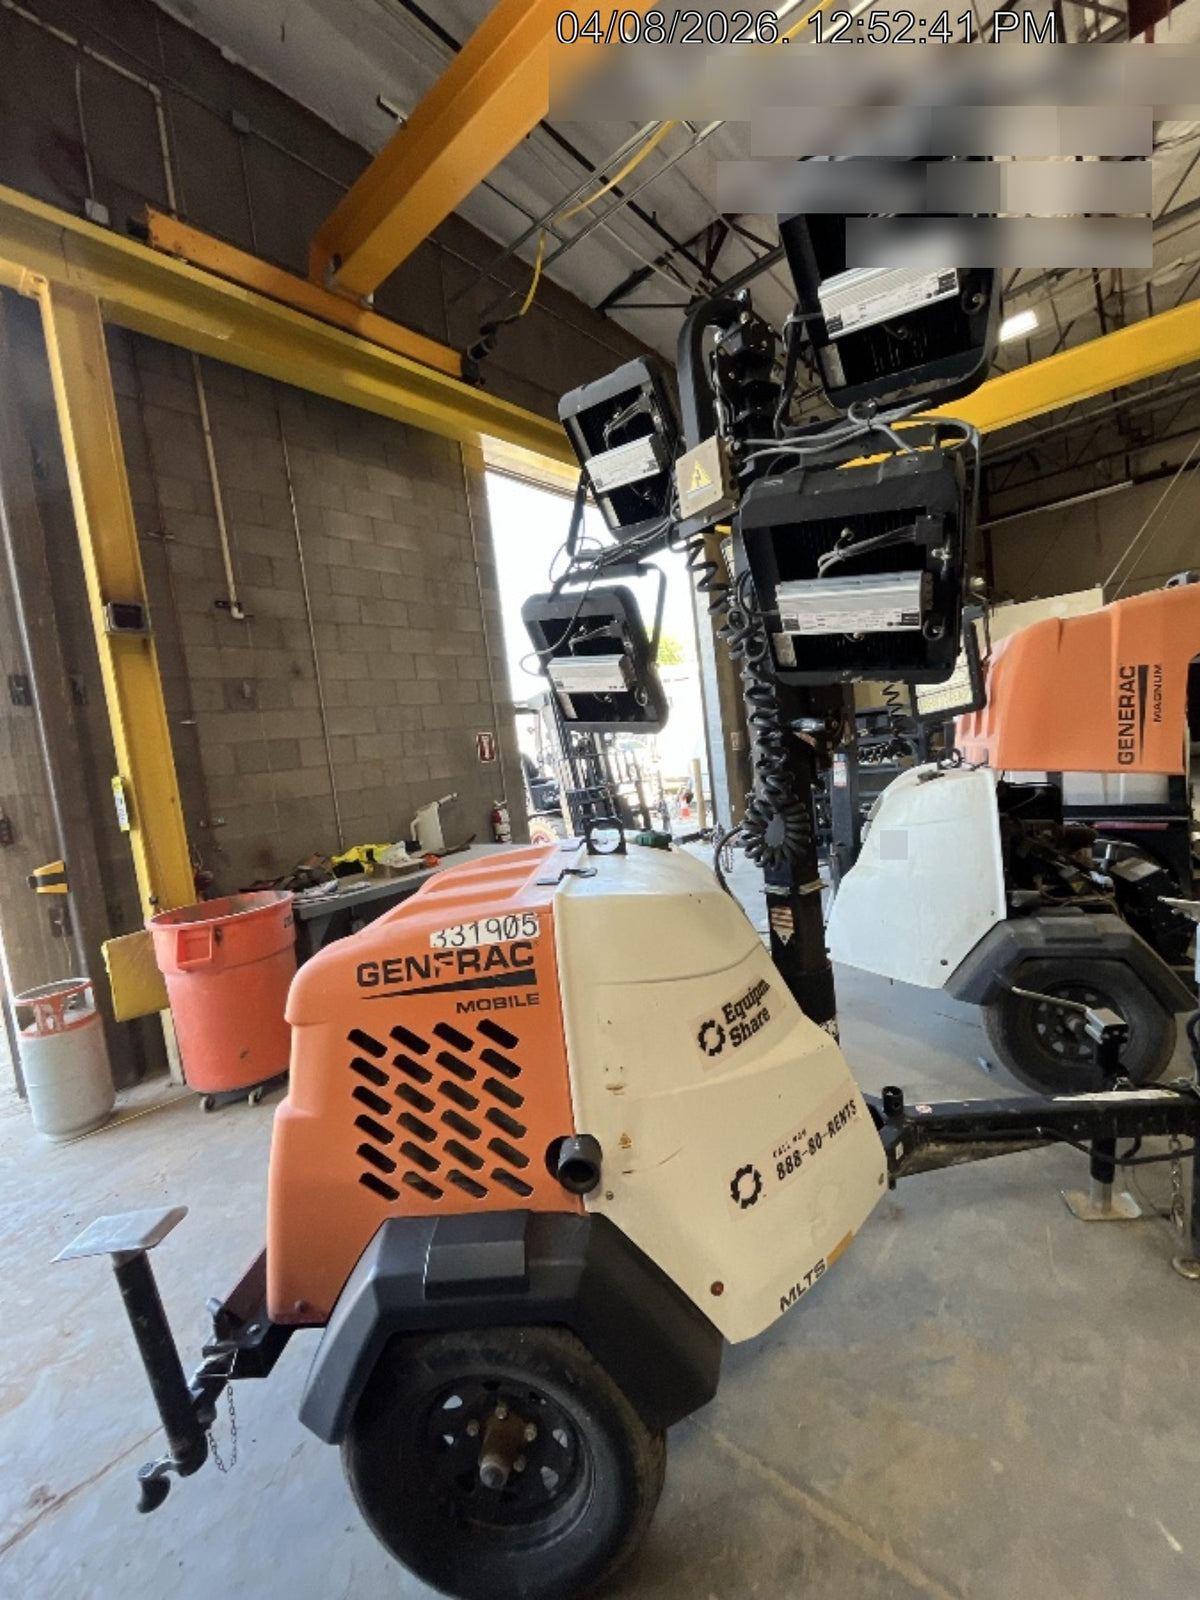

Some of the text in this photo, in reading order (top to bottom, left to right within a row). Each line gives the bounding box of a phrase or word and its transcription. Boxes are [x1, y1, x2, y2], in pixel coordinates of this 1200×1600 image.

[1153, 664, 1162, 723] MAGNUM
[1117, 665, 1136, 765] GENERAC
[433, 912, 538, 948] 331905
[456, 993, 540, 1014] MOBILE
[729, 1007, 771, 1048] Share
